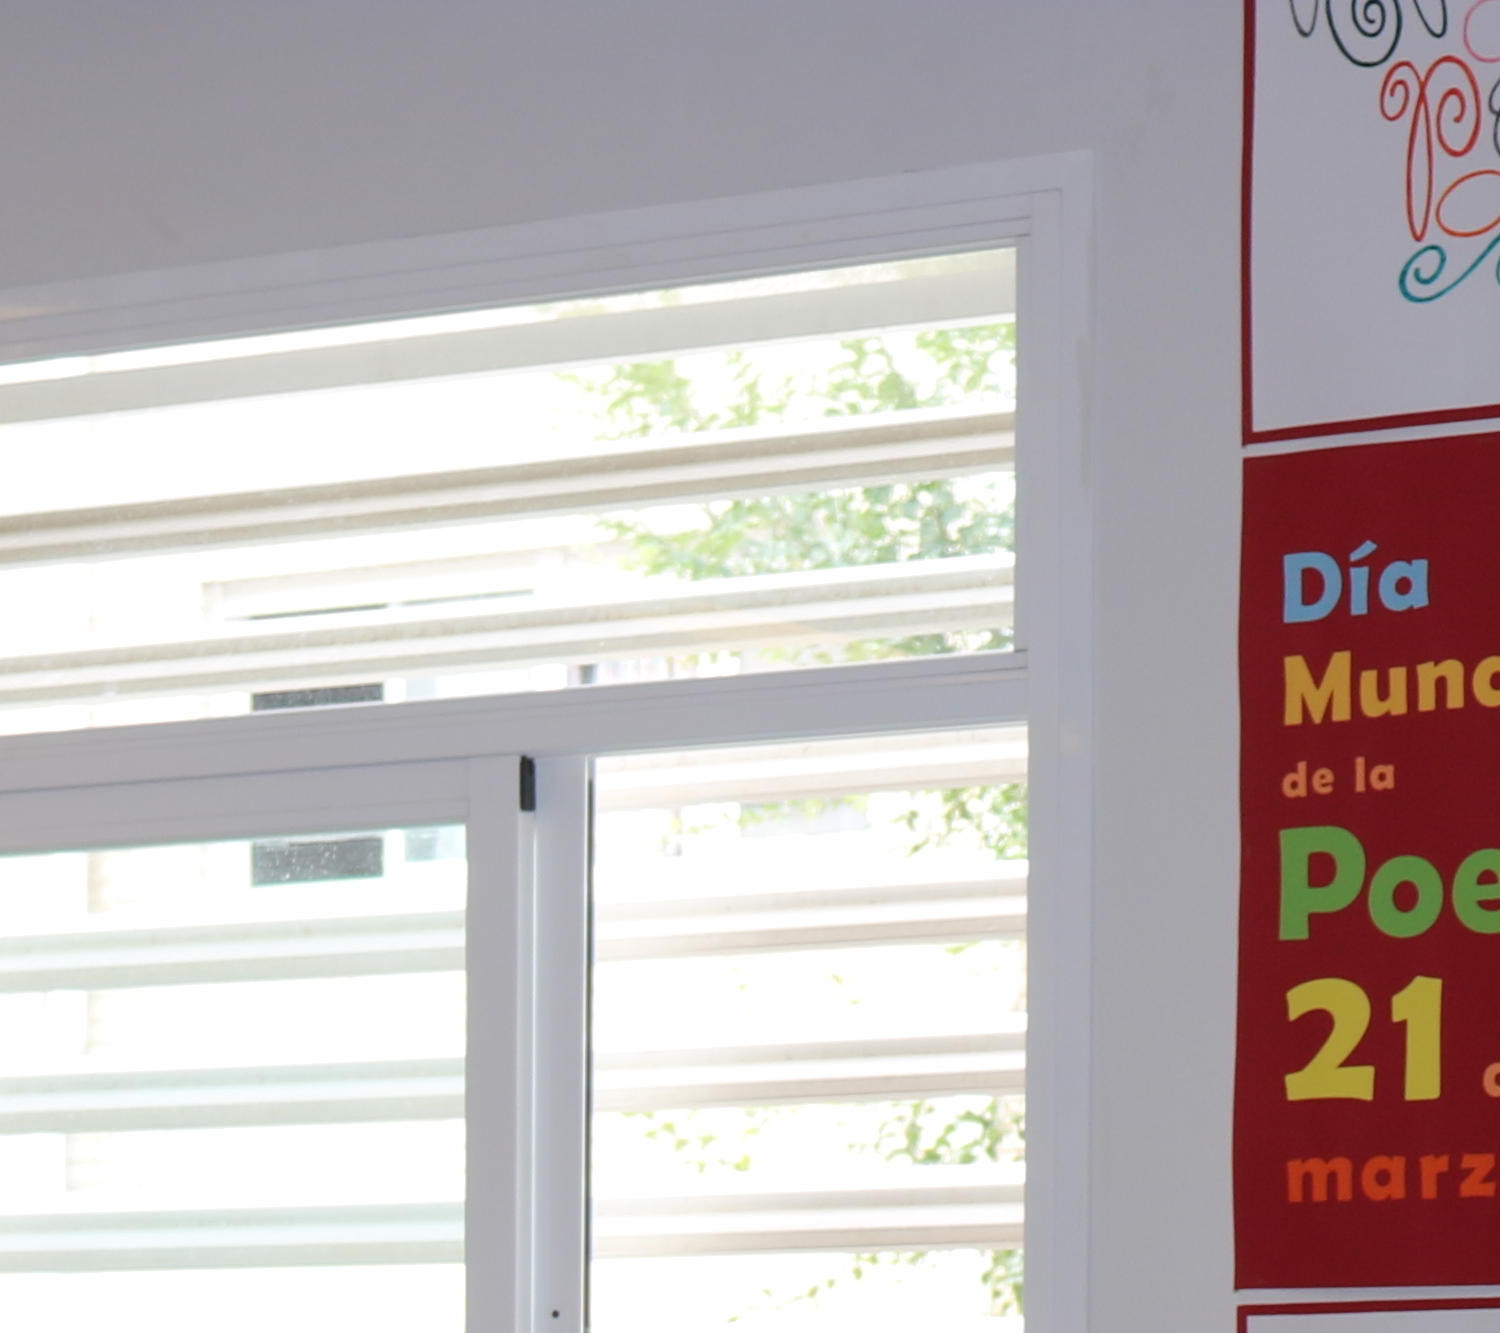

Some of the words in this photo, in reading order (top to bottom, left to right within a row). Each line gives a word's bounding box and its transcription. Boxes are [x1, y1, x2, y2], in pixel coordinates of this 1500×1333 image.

[1283, 539, 1429, 624] Día
[1281, 761, 1334, 798] de
[1354, 756, 1396, 793] la
[1284, 974, 1443, 1102] 21
